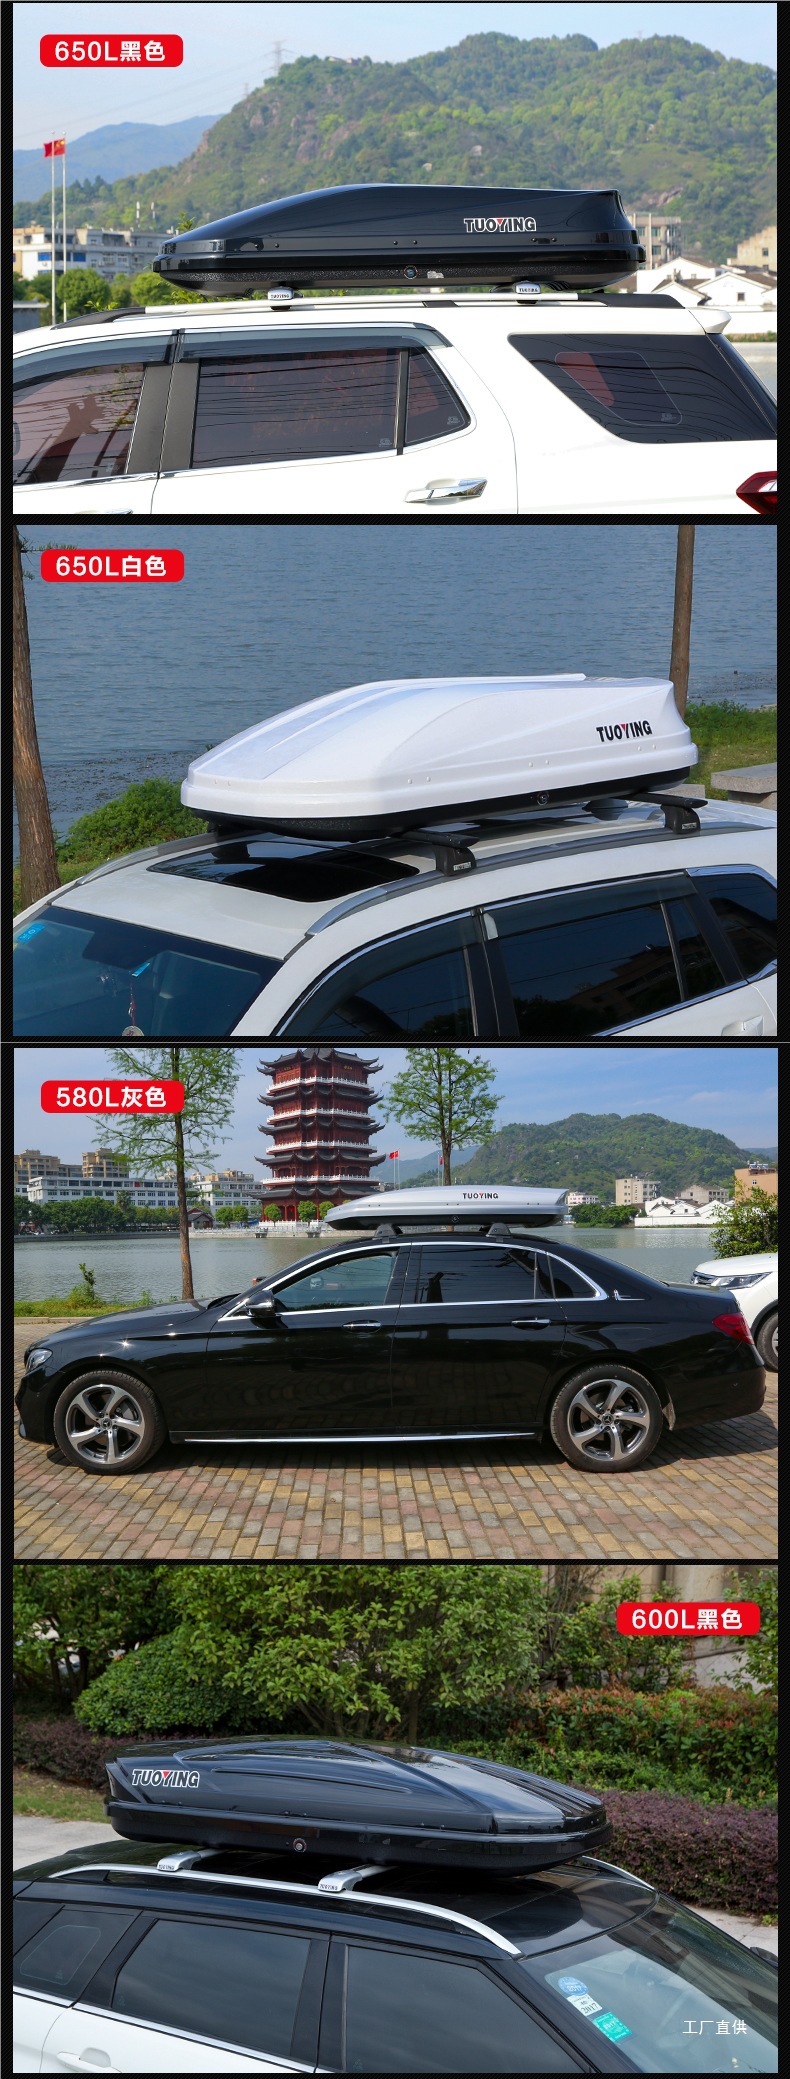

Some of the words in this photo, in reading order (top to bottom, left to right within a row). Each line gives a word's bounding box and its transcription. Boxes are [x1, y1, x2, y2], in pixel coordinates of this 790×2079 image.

[464, 217, 536, 232] TUOYING
[596, 720, 652, 742] TUOYING
[132, 1769, 200, 1788] TUOYING
